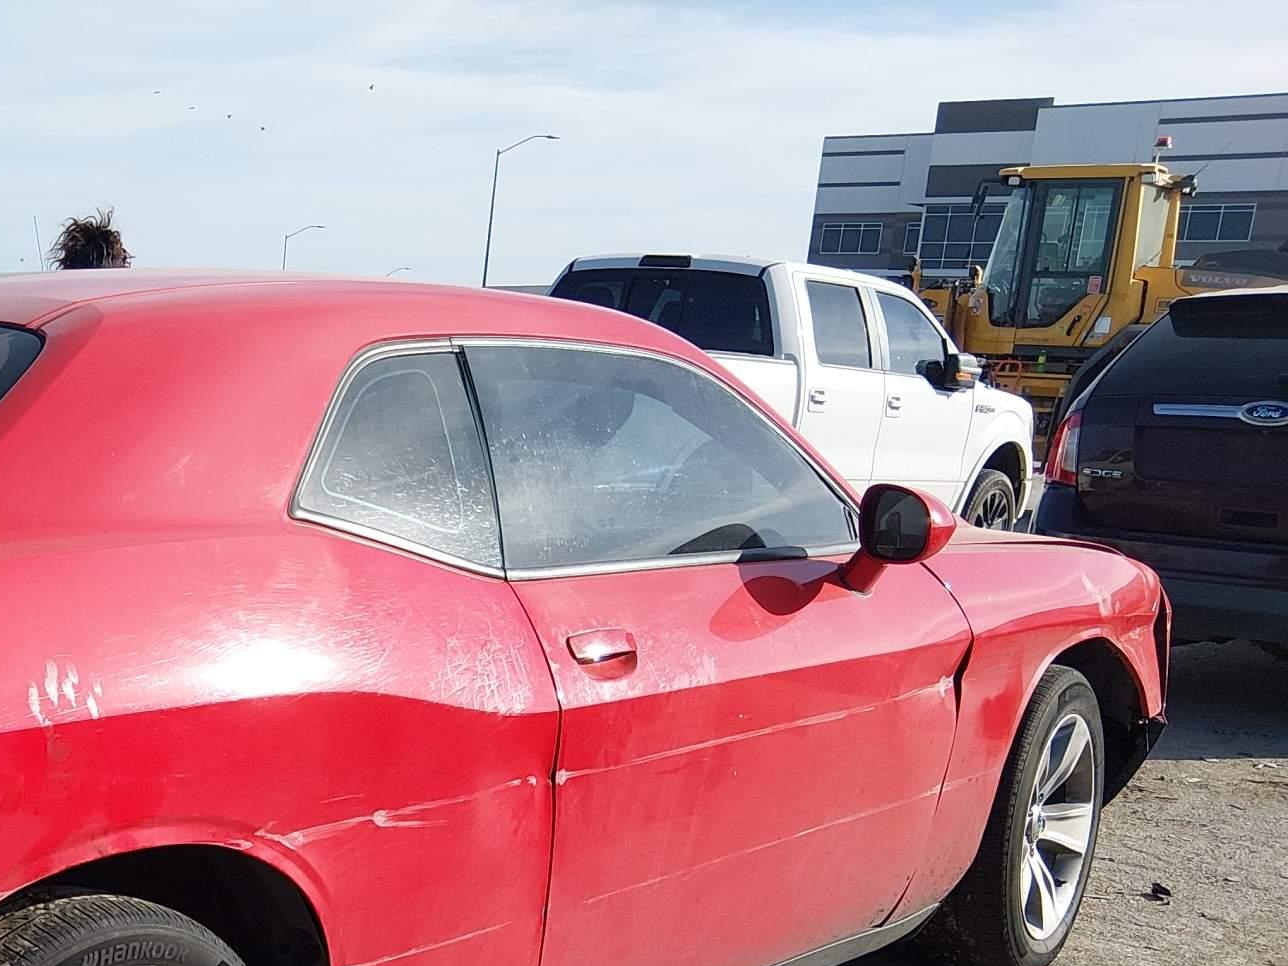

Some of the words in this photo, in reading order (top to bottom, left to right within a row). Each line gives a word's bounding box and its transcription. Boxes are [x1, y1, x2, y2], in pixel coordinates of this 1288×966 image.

[1189, 274, 1248, 285] VOLVO
[1252, 406, 1282, 418] Ford
[1082, 467, 1123, 479] EDGE
